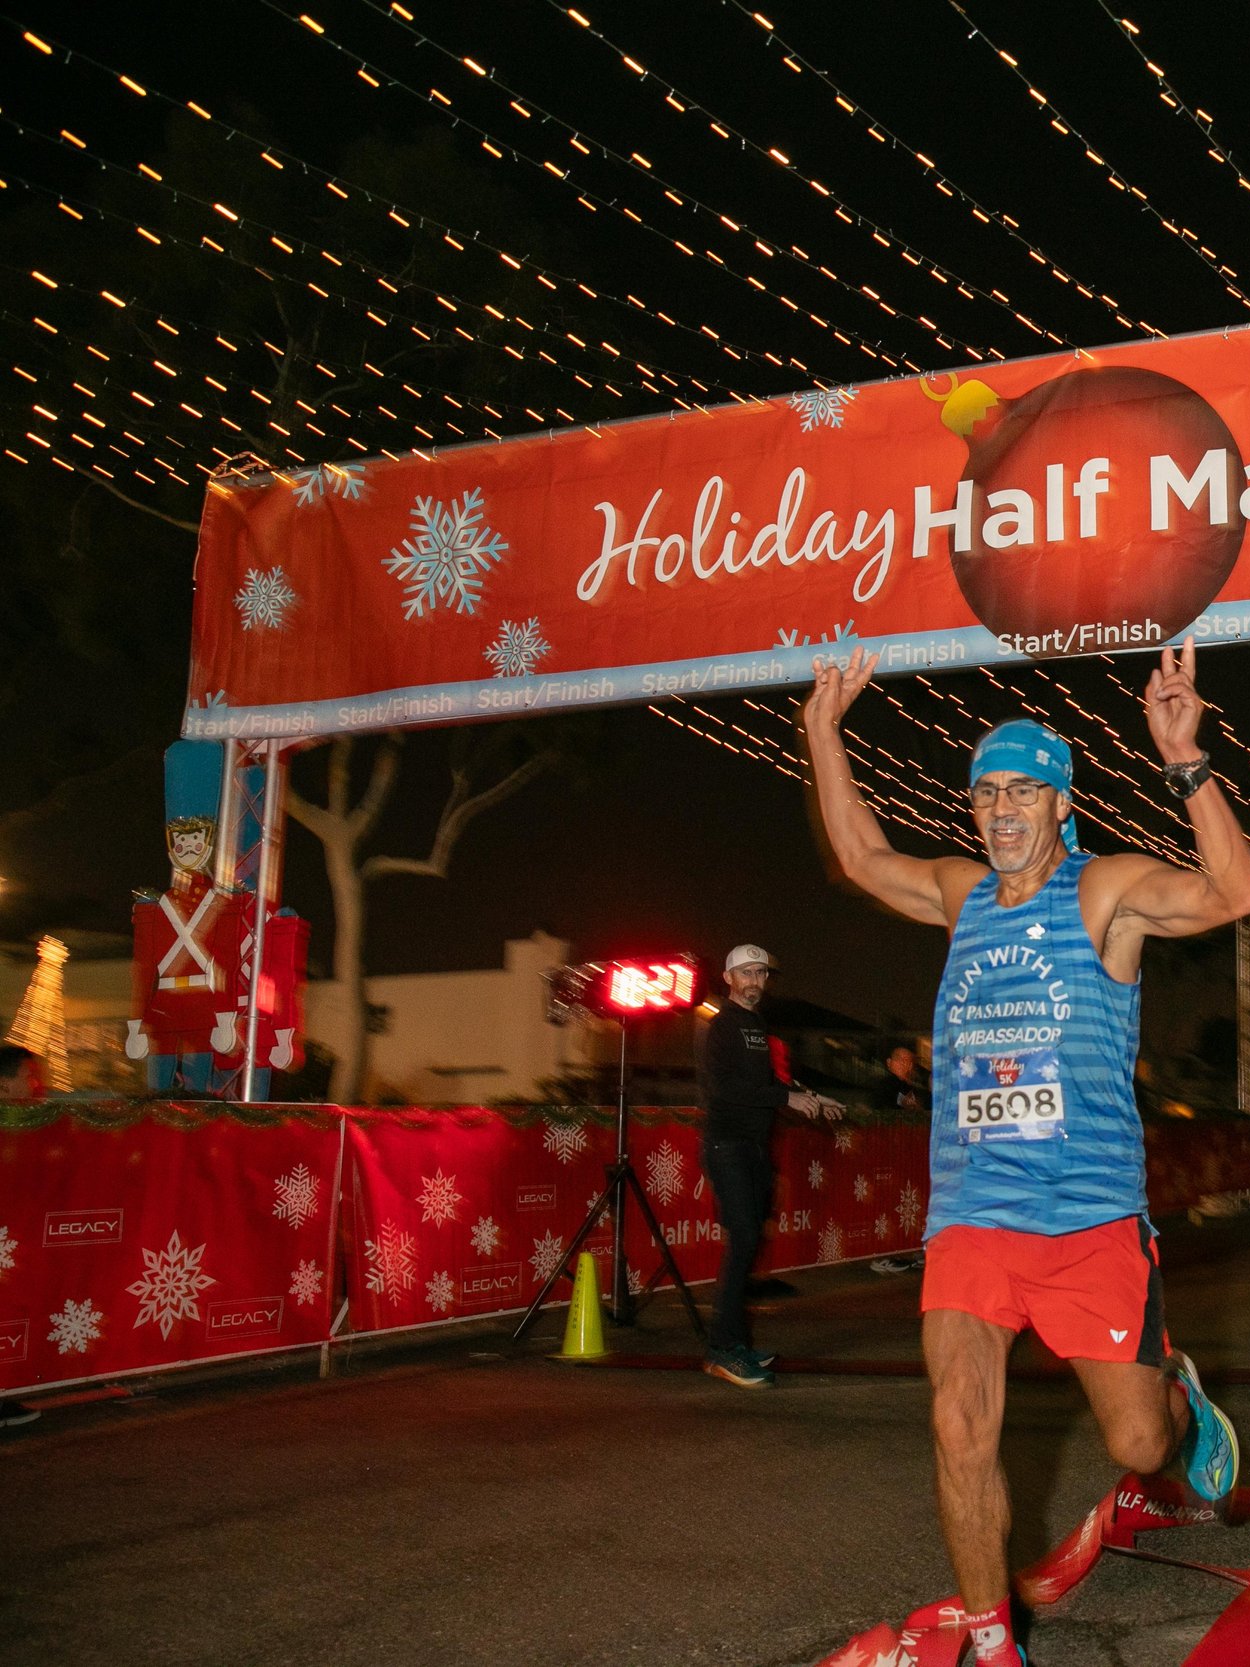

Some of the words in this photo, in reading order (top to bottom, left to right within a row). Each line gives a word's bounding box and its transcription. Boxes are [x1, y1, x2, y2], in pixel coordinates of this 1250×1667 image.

[577, 467, 896, 602] Holiday
[912, 457, 1109, 558] Half
[338, 692, 452, 727] Start/Finish
[477, 676, 614, 710] Start/Finish
[642, 658, 783, 694] Start/Finish
[812, 637, 965, 673] Stat/Finish
[997, 619, 1161, 655] Start/Finish
[948, 960, 982, 1025] RUN
[986, 945, 1053, 980] WITH
[1048, 979, 1071, 1021] US
[965, 1001, 1047, 1020] PASADENA
[954, 1027, 1062, 1048] AMBASSADOR
[988, 1058, 1024, 1076] Holiday
[1000, 1074, 1013, 1085] 5K
[966, 1088, 1056, 1123] 5608
[519, 1193, 554, 1204] LEGACY
[48, 1221, 118, 1235] LEGACY
[779, 1212, 788, 1233] &
[793, 1210, 812, 1232] 5K
[463, 1275, 518, 1294] LEGACY
[211, 1309, 278, 1328] LEGACY
[1117, 1491, 1143, 1510] ALF
